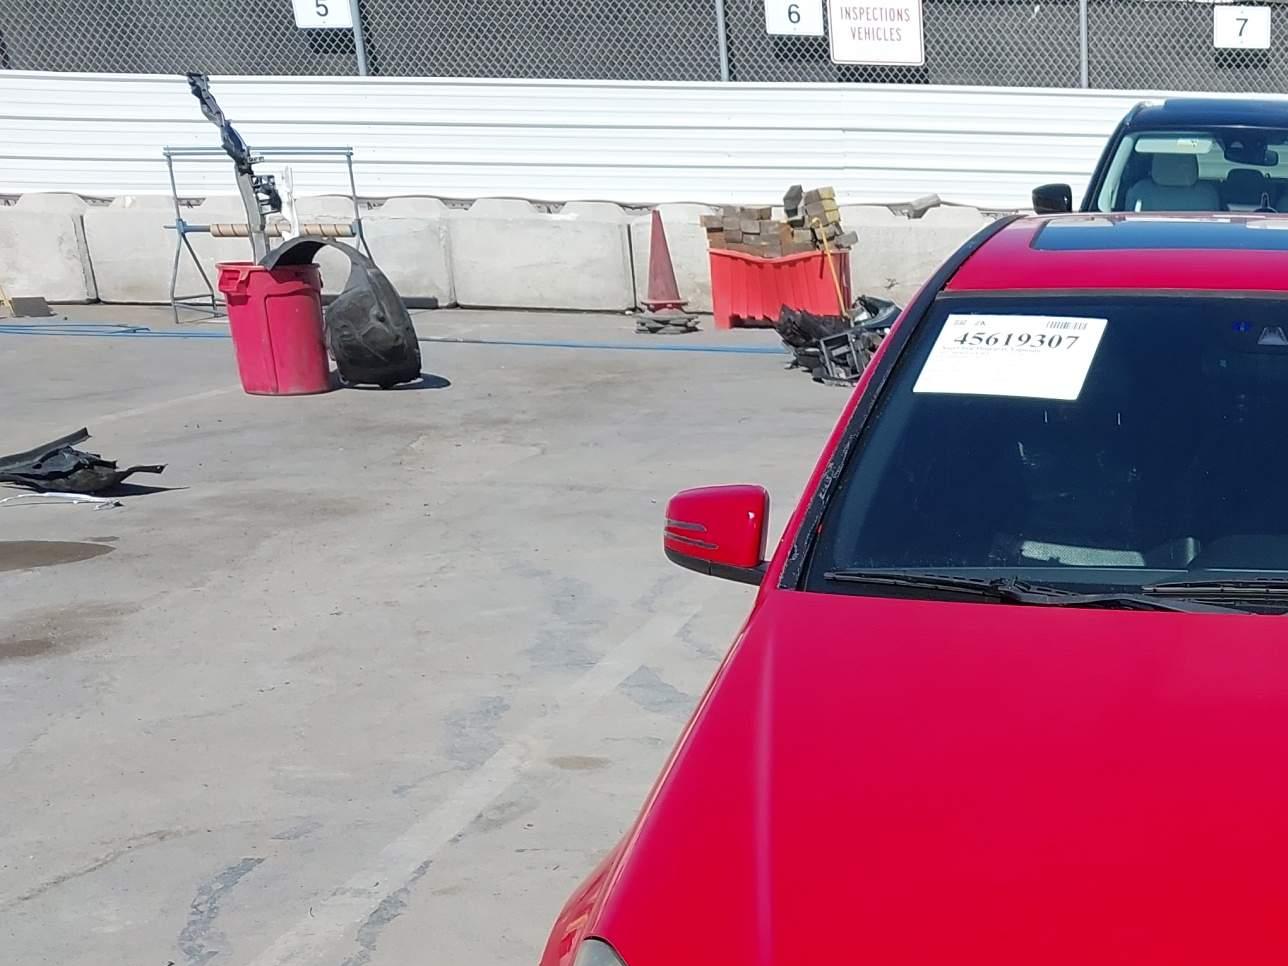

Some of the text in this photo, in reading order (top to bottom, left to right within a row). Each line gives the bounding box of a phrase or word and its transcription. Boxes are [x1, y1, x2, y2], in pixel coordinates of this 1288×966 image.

[315, 0, 329, 17] 5
[787, 3, 801, 24] 6
[839, 6, 911, 23] INSPECTIONS
[850, 27, 902, 42] VEHICLES
[1235, 17, 1249, 37] 7
[953, 331, 1080, 350] 45619307
